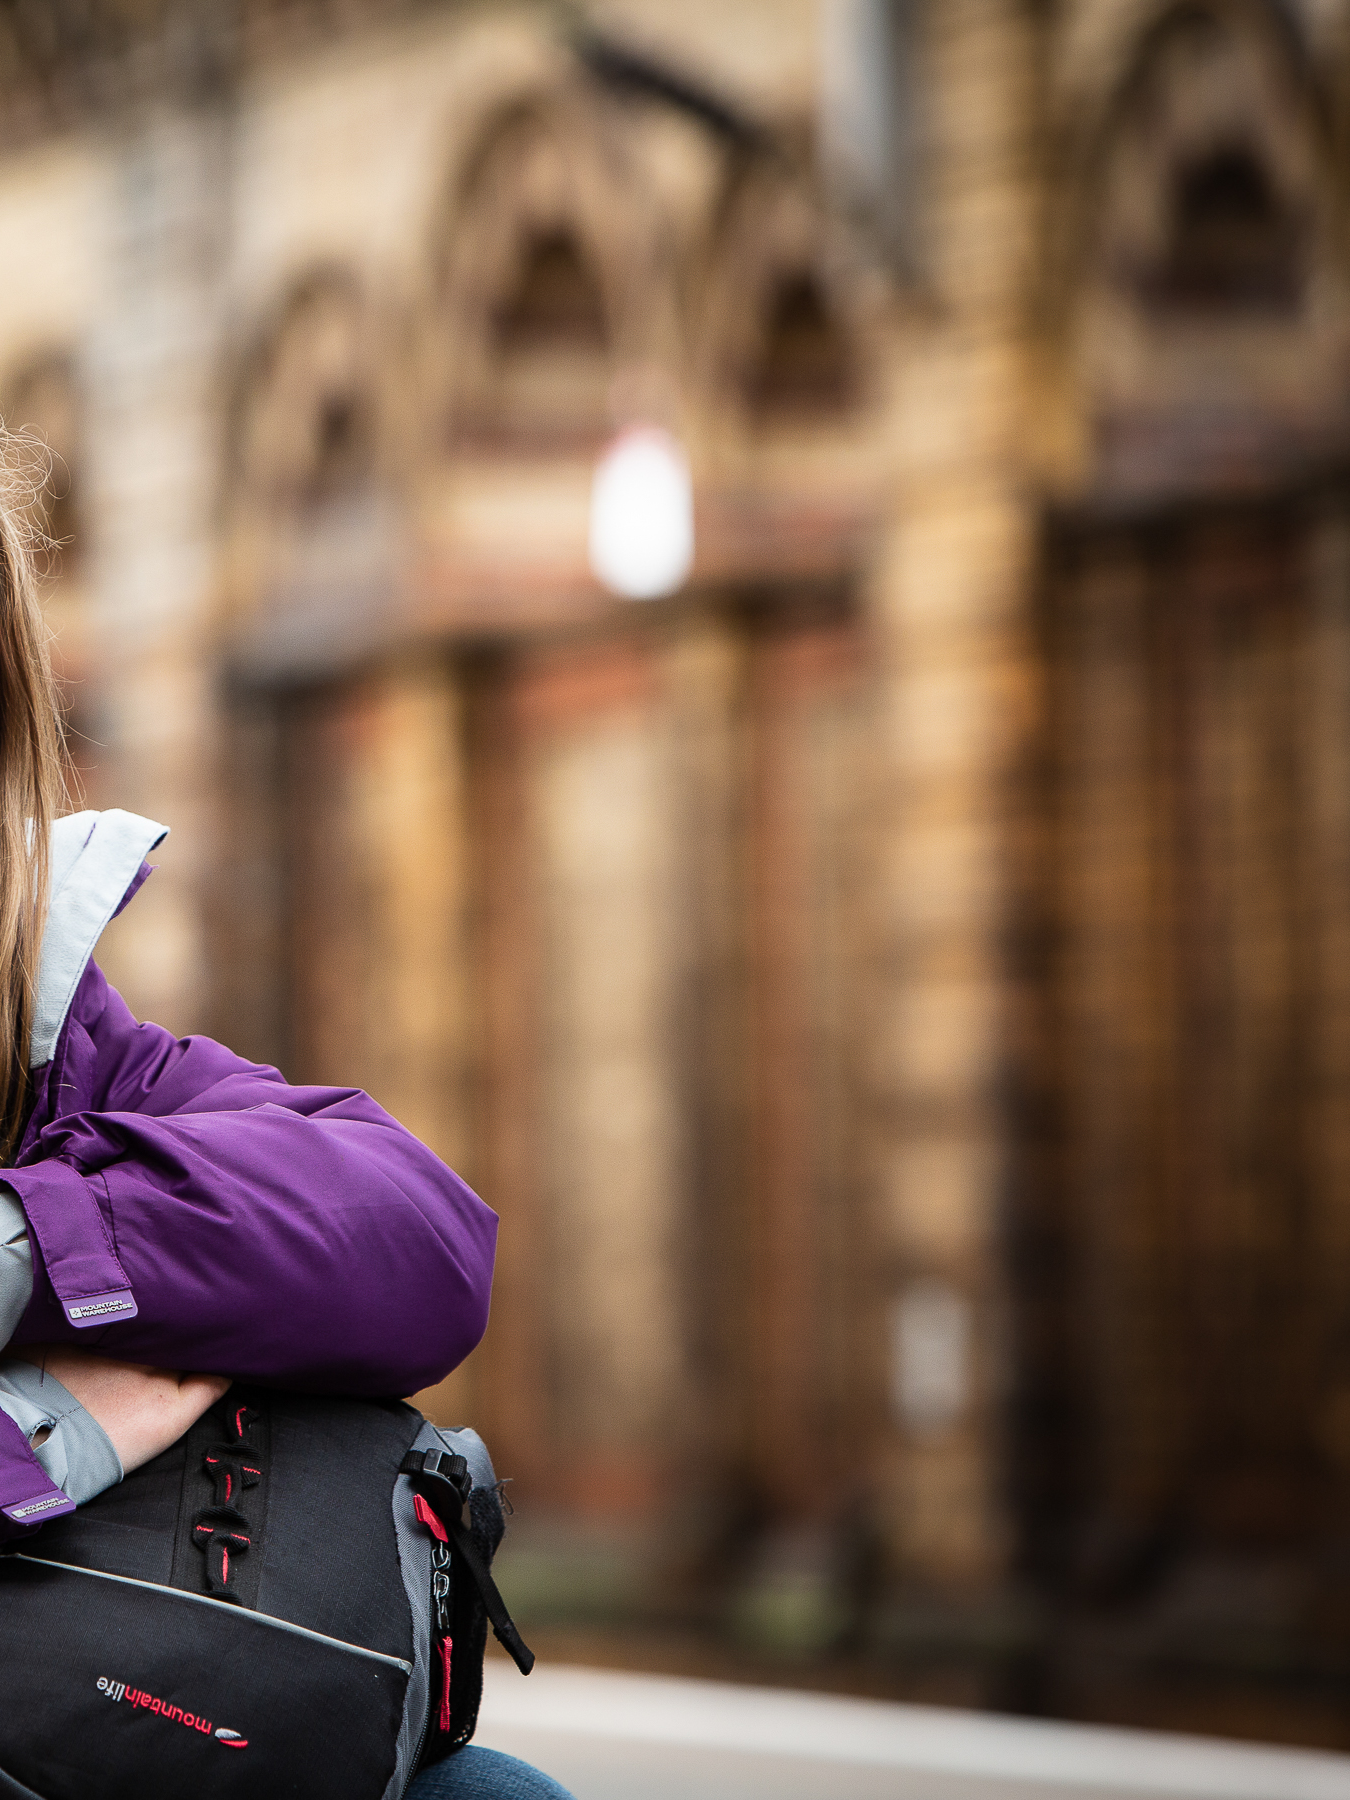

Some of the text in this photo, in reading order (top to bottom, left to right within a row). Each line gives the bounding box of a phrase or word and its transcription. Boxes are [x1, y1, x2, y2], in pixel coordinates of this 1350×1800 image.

[80, 1300, 123, 1312] MOUNTAIN
[81, 1303, 133, 1317] WAREHOUSE
[96, 1676, 212, 1735] mountainlife
